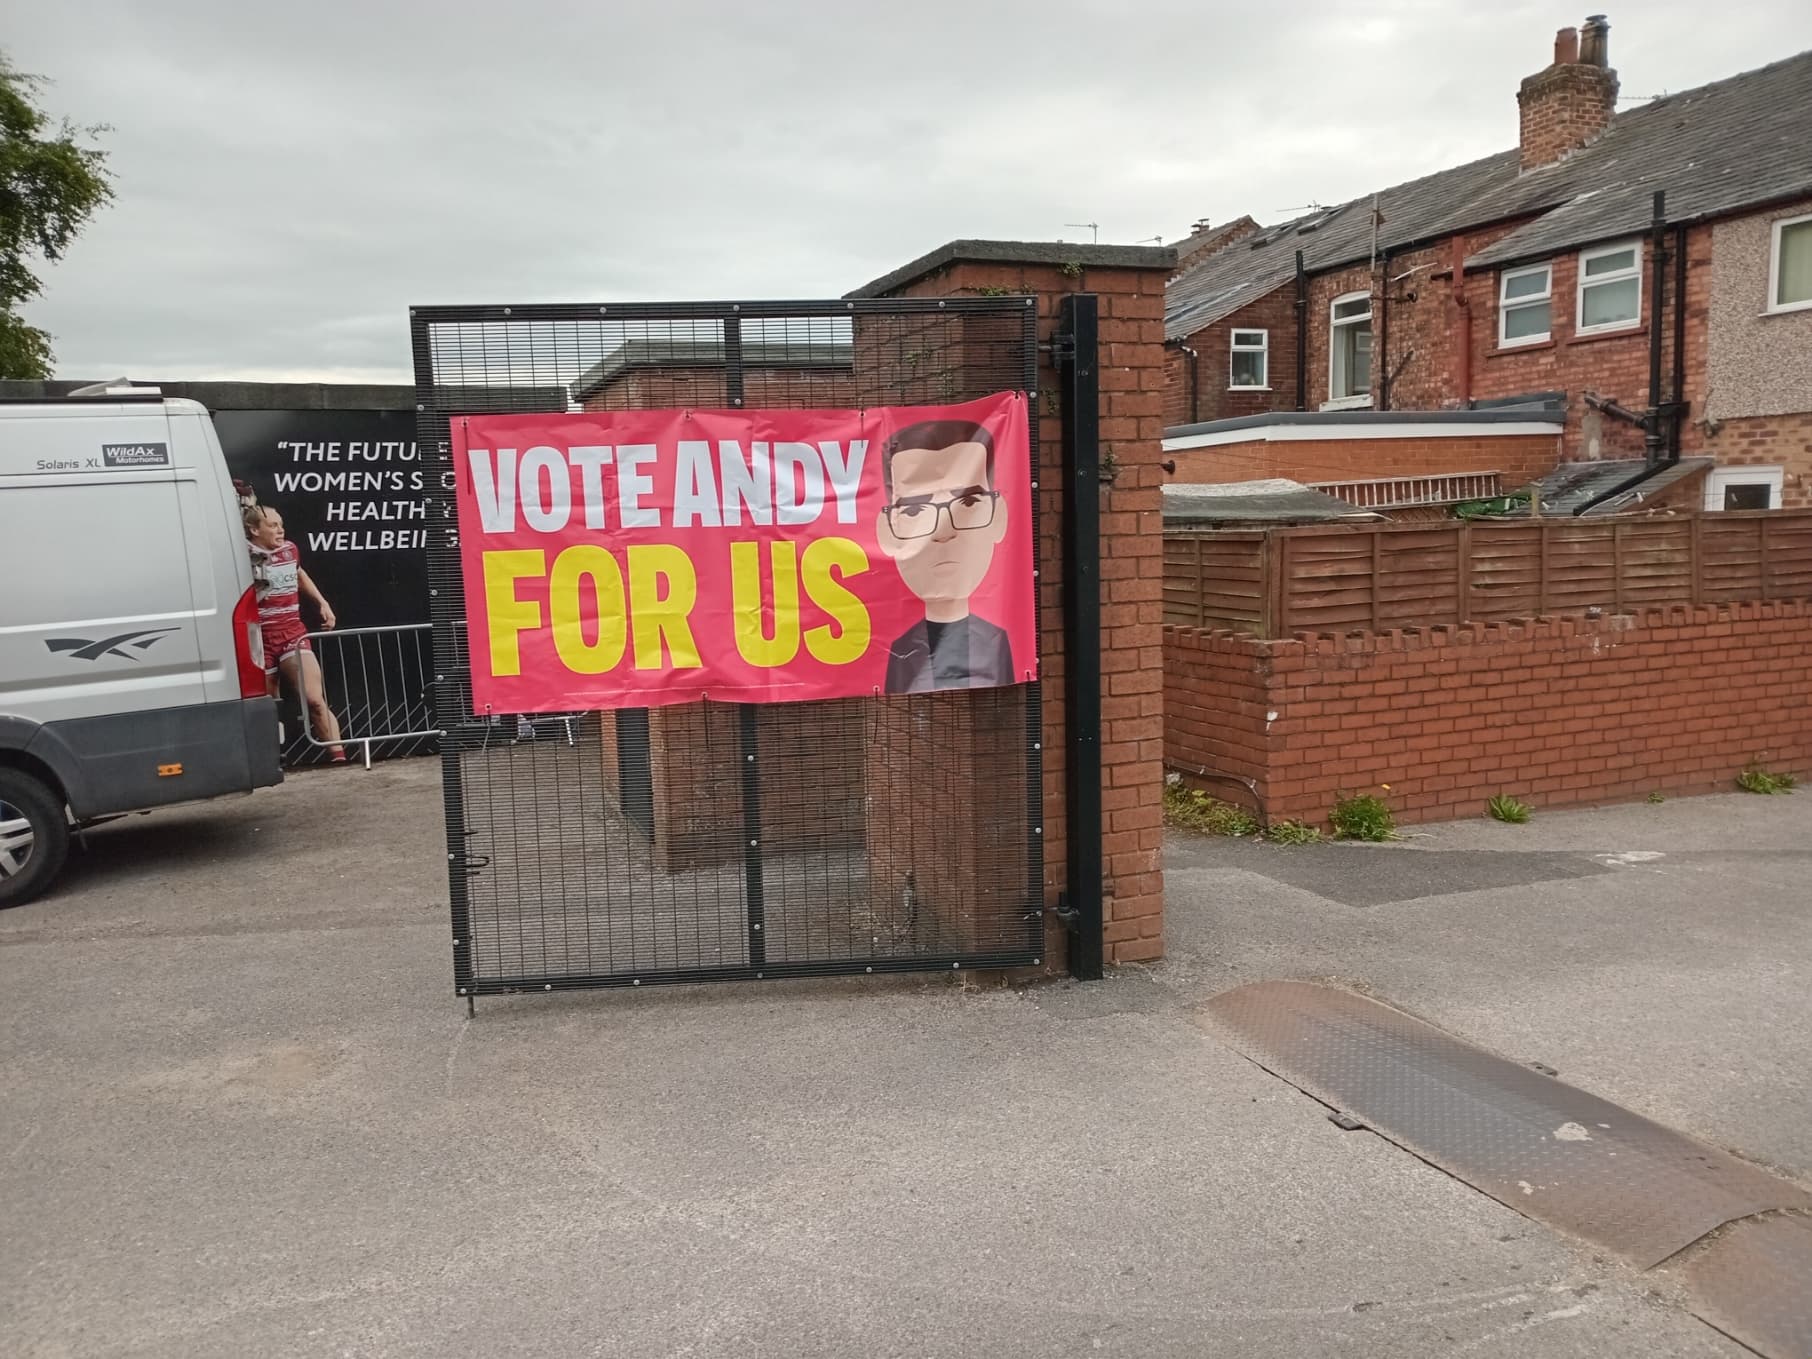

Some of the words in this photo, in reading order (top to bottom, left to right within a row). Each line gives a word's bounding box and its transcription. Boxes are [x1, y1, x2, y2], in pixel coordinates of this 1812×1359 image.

[106, 446, 155, 457] WildAx
[36, 459, 80, 470] Solaris
[85, 458, 101, 468] XL
[273, 471, 404, 492] WOMEN’S
[468, 443, 658, 534] VOTE
[672, 439, 869, 529] ANDY
[481, 544, 703, 678] FOR
[730, 536, 871, 668] US
